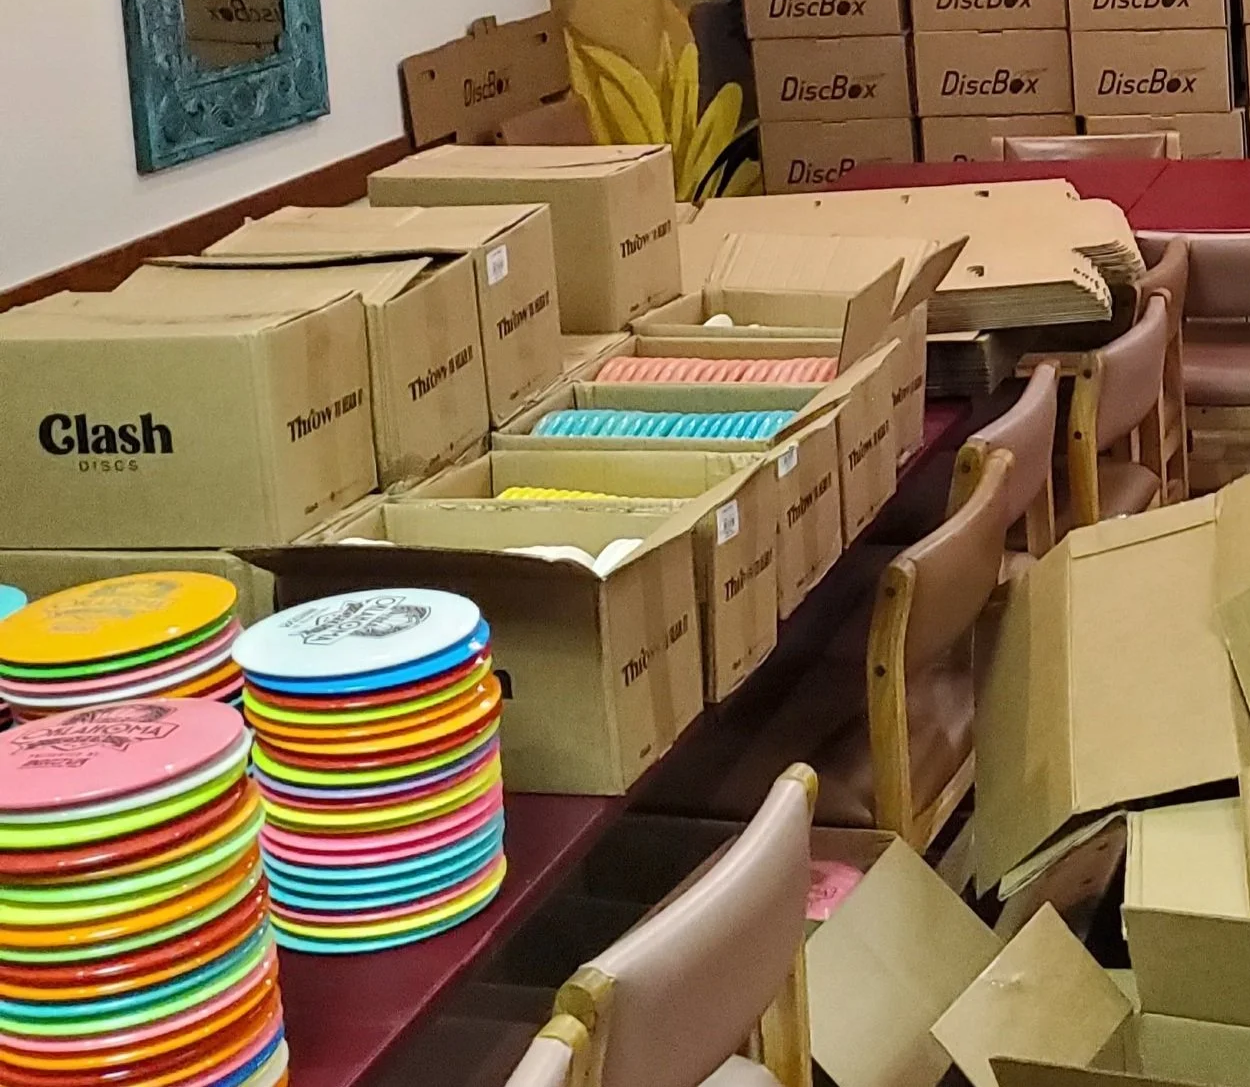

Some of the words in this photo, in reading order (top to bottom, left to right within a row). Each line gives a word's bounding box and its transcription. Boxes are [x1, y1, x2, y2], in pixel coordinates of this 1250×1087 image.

[463, 69, 510, 107] DiscBox
[780, 74, 877, 102] DiscBox
[940, 69, 1039, 96] DiscBox
[1097, 68, 1197, 96] DiscBox
[38, 412, 174, 455] Clash
[79, 460, 139, 472] DISCS
